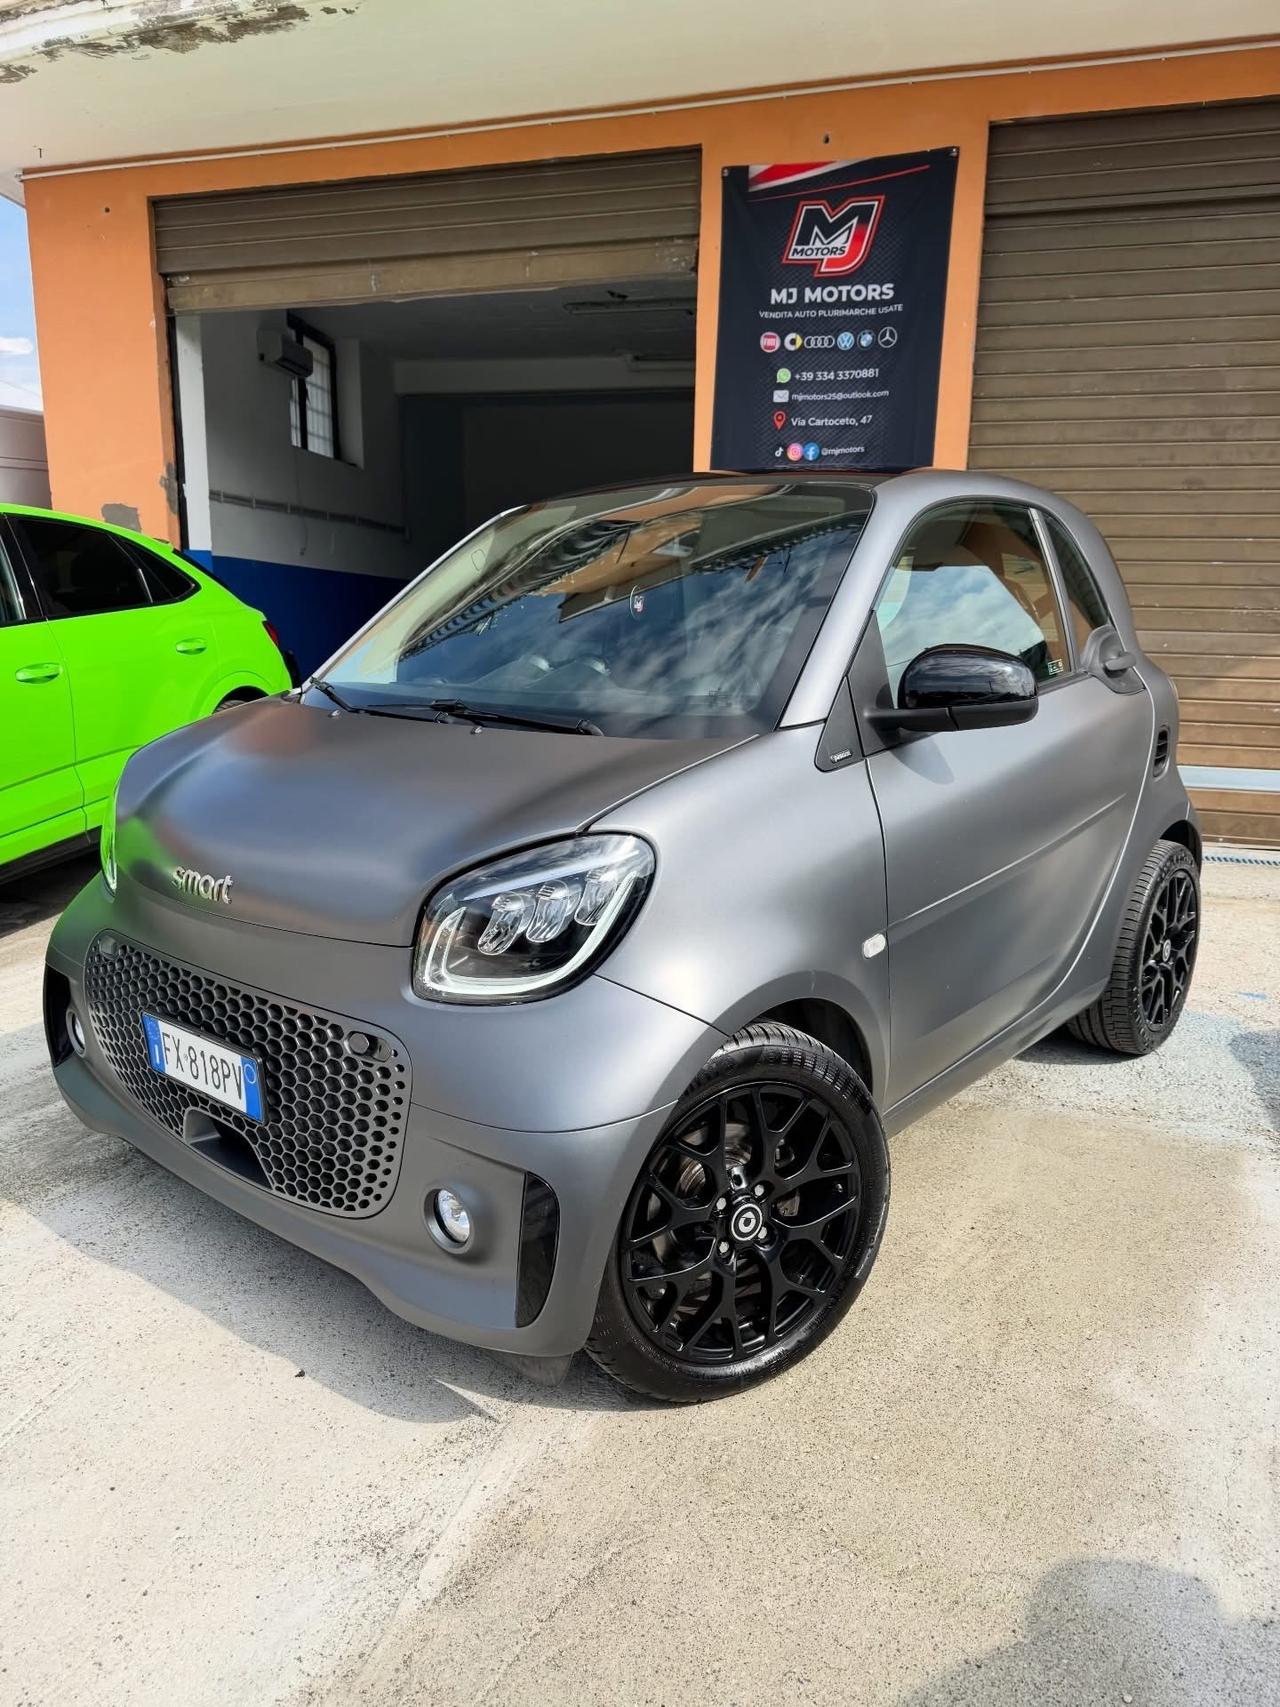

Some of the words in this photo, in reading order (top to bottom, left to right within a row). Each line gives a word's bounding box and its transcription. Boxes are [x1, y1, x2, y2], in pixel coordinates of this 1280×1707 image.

[791, 246, 847, 257] MOTORS
[770, 287, 798, 305] MJ
[804, 283, 894, 303] MOTORS
[759, 310, 793, 319] VENDITA
[794, 309, 817, 318] AUTO
[818, 307, 876, 317] PLURIMARCHE
[878, 303, 904, 314] USATE
[795, 372, 814, 382] +39
[816, 371, 835, 381] 334
[837, 368, 880, 380] 3370881
[791, 390, 889, 401] mjmotors25@outlook.com
[791, 417, 806, 427] Via
[808, 416, 858, 427] Cartoceto,
[861, 415, 873, 425] 47
[821, 446, 865, 456] @mjmotors
[172, 865, 234, 905] smart
[161, 1031, 185, 1073] FX
[188, 1045, 242, 1100] 818PV
